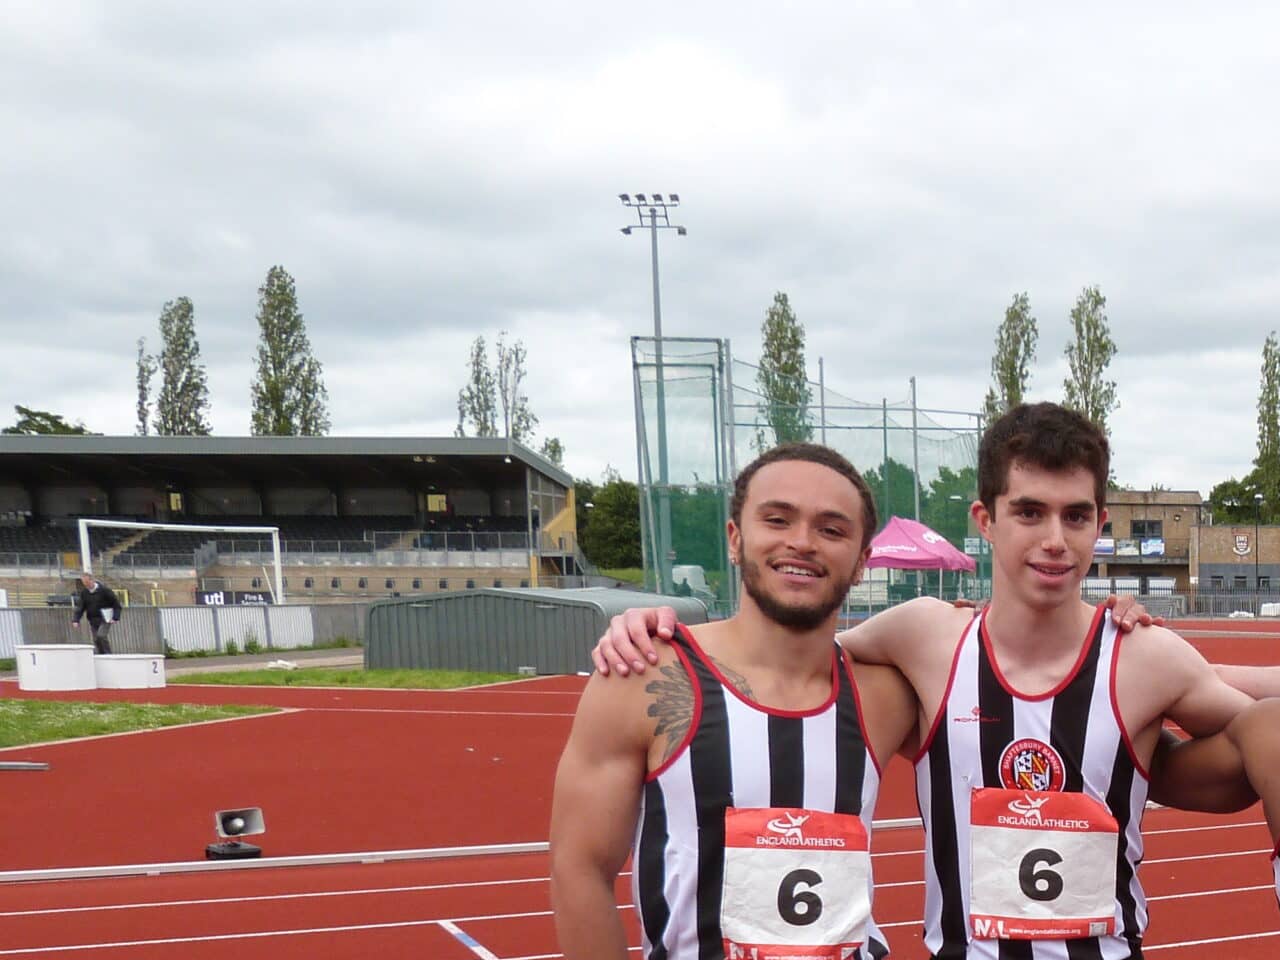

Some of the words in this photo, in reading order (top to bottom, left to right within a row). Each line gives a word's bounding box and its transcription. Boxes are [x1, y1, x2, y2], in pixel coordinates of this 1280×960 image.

[31, 652, 37, 666] 1
[152, 661, 159, 674] 2
[997, 815, 1038, 826] ENGLAND
[1042, 818, 1089, 829] ATHLETICS
[756, 836, 800, 846] ENGLAND
[803, 837, 845, 847] ATHLETICS
[1018, 847, 1064, 902] 6
[777, 868, 824, 926] 6
